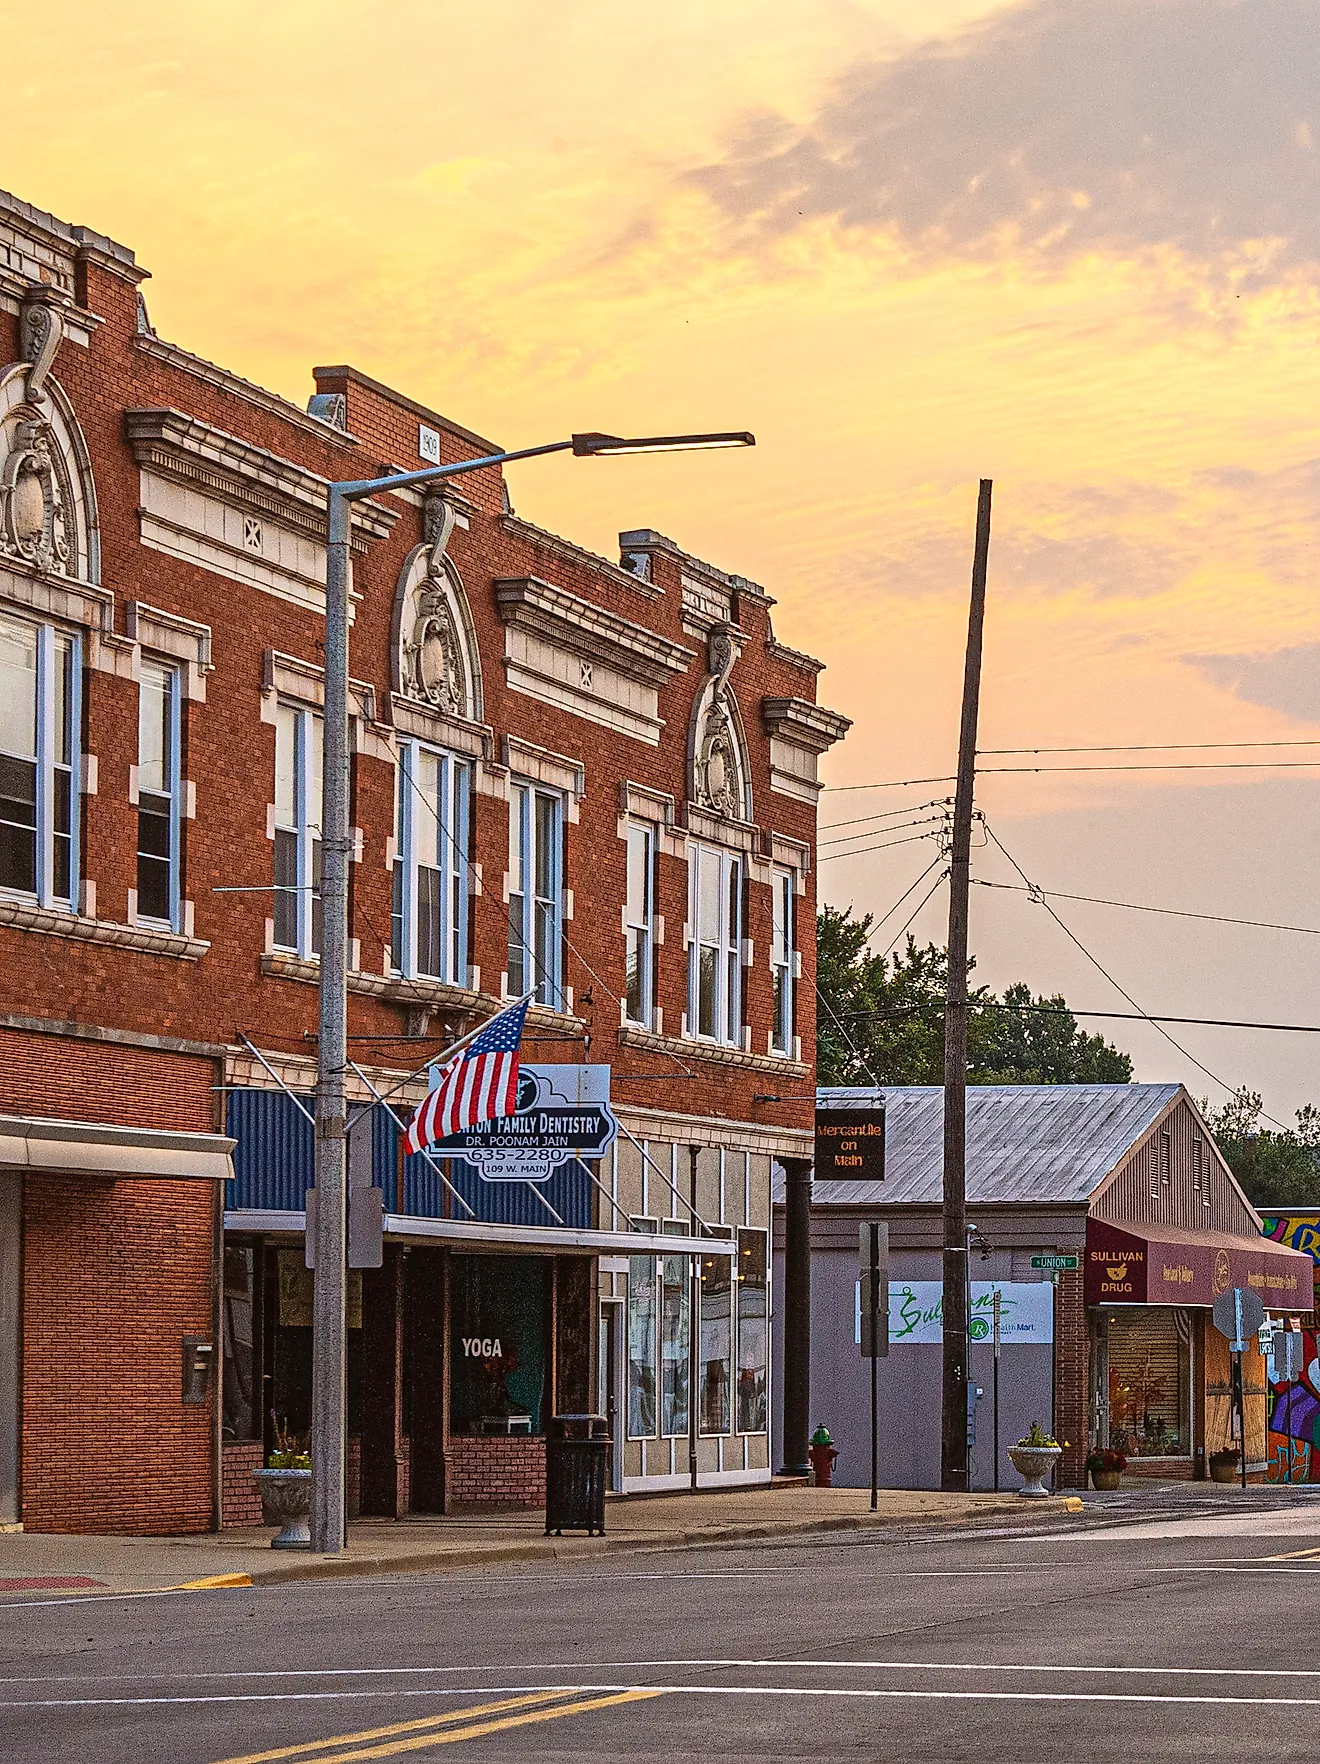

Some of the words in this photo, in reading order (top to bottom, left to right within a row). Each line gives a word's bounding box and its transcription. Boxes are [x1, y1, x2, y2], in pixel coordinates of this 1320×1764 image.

[497, 1116, 537, 1134] FAMILY
[539, 1112, 600, 1135] DENTISTRY
[817, 1123, 882, 1136] Mercantile
[465, 1136, 485, 1146] DR.
[489, 1136, 539, 1146] POONAM
[543, 1135, 568, 1146] JAIN
[840, 1141, 858, 1151] on
[471, 1149, 562, 1161] 635-2280
[834, 1154, 863, 1167] Main
[486, 1164, 503, 1173] 109
[506, 1164, 518, 1173] W.
[521, 1164, 547, 1173] MAIN
[1090, 1251, 1143, 1261] SULLIVAN
[1041, 1257, 1067, 1268] UNION
[1101, 1282, 1133, 1292] DRUG
